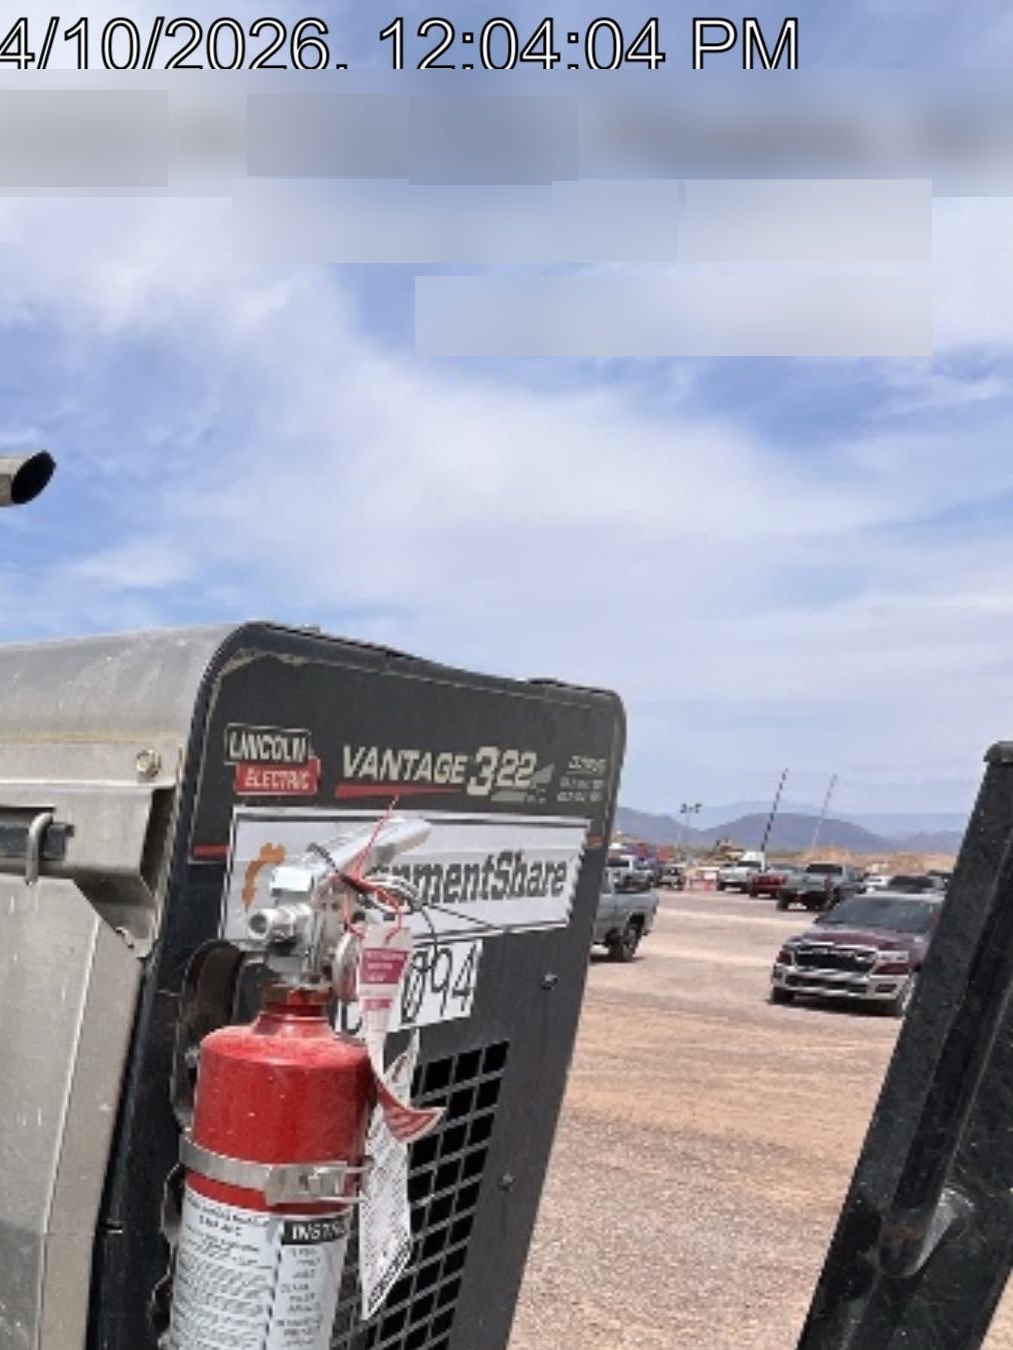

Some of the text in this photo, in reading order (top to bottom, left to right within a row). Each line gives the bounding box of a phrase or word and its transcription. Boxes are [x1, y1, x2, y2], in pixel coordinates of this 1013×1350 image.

[229, 730, 308, 763] LINCOLN
[244, 767, 310, 791] ELECTRIC
[342, 745, 468, 784] VANTAGE
[466, 746, 538, 797] 322
